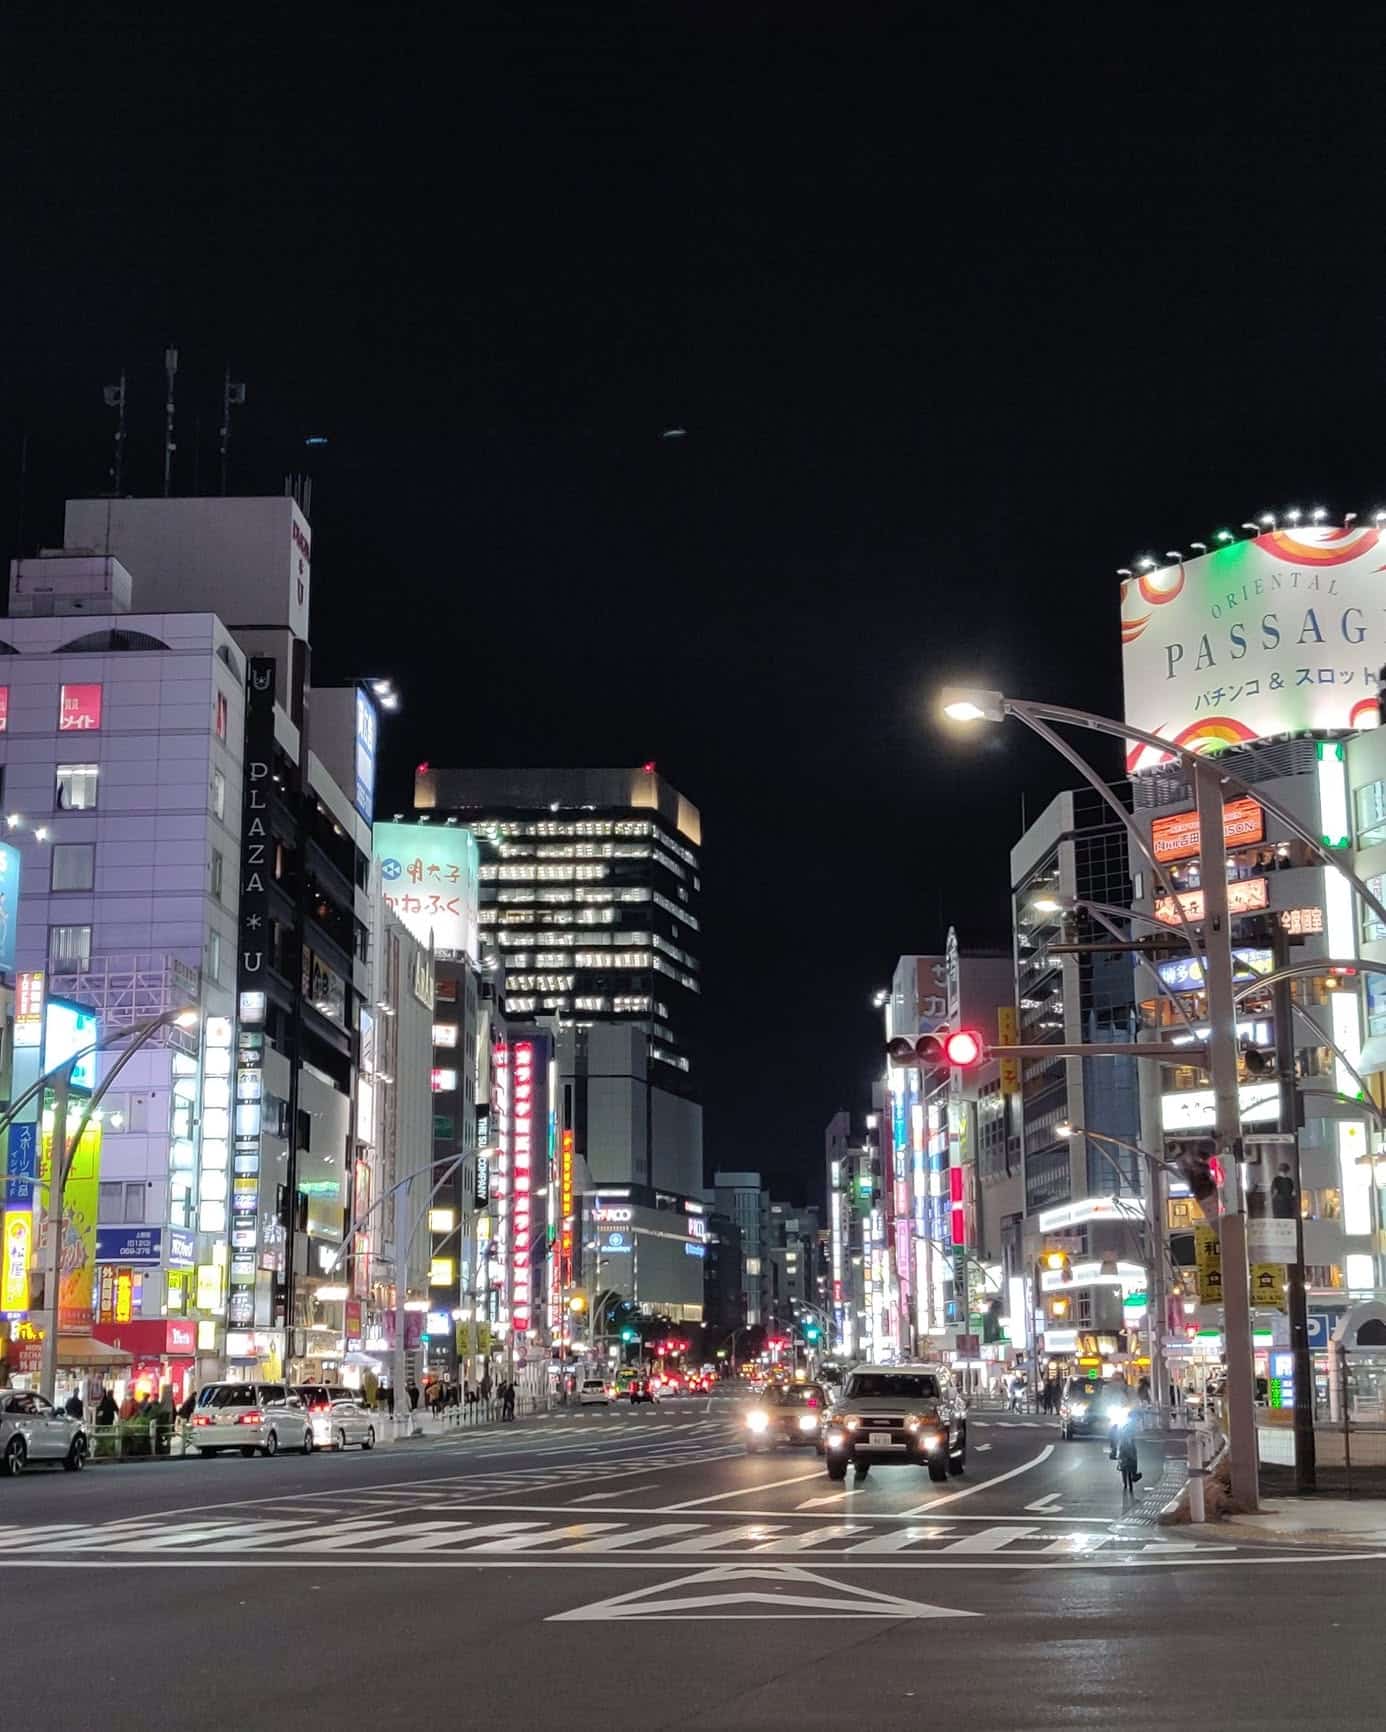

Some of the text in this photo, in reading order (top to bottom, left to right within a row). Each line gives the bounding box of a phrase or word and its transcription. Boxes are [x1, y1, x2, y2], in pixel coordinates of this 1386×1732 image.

[1210, 572, 1339, 620] ORIENTAL
[1164, 607, 1386, 680] PASSAG
[1194, 666, 1379, 711] パチンコ & スロット
[406, 857, 462, 884] 明太子
